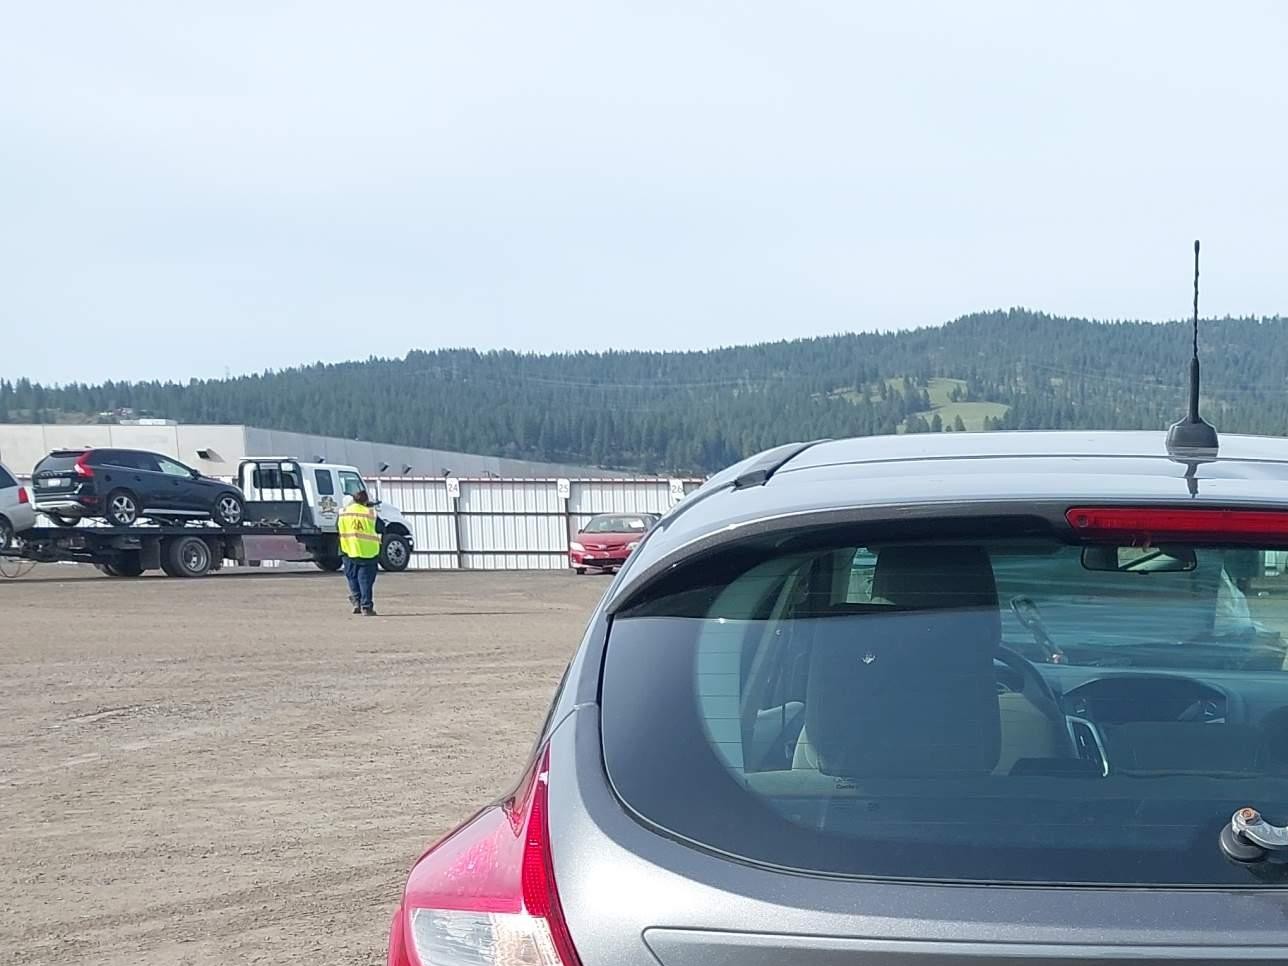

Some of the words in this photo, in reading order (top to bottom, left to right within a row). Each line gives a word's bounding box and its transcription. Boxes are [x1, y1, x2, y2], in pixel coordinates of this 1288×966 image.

[447, 483, 458, 493] 24
[559, 483, 569, 493] 25
[671, 484, 683, 494] 26
